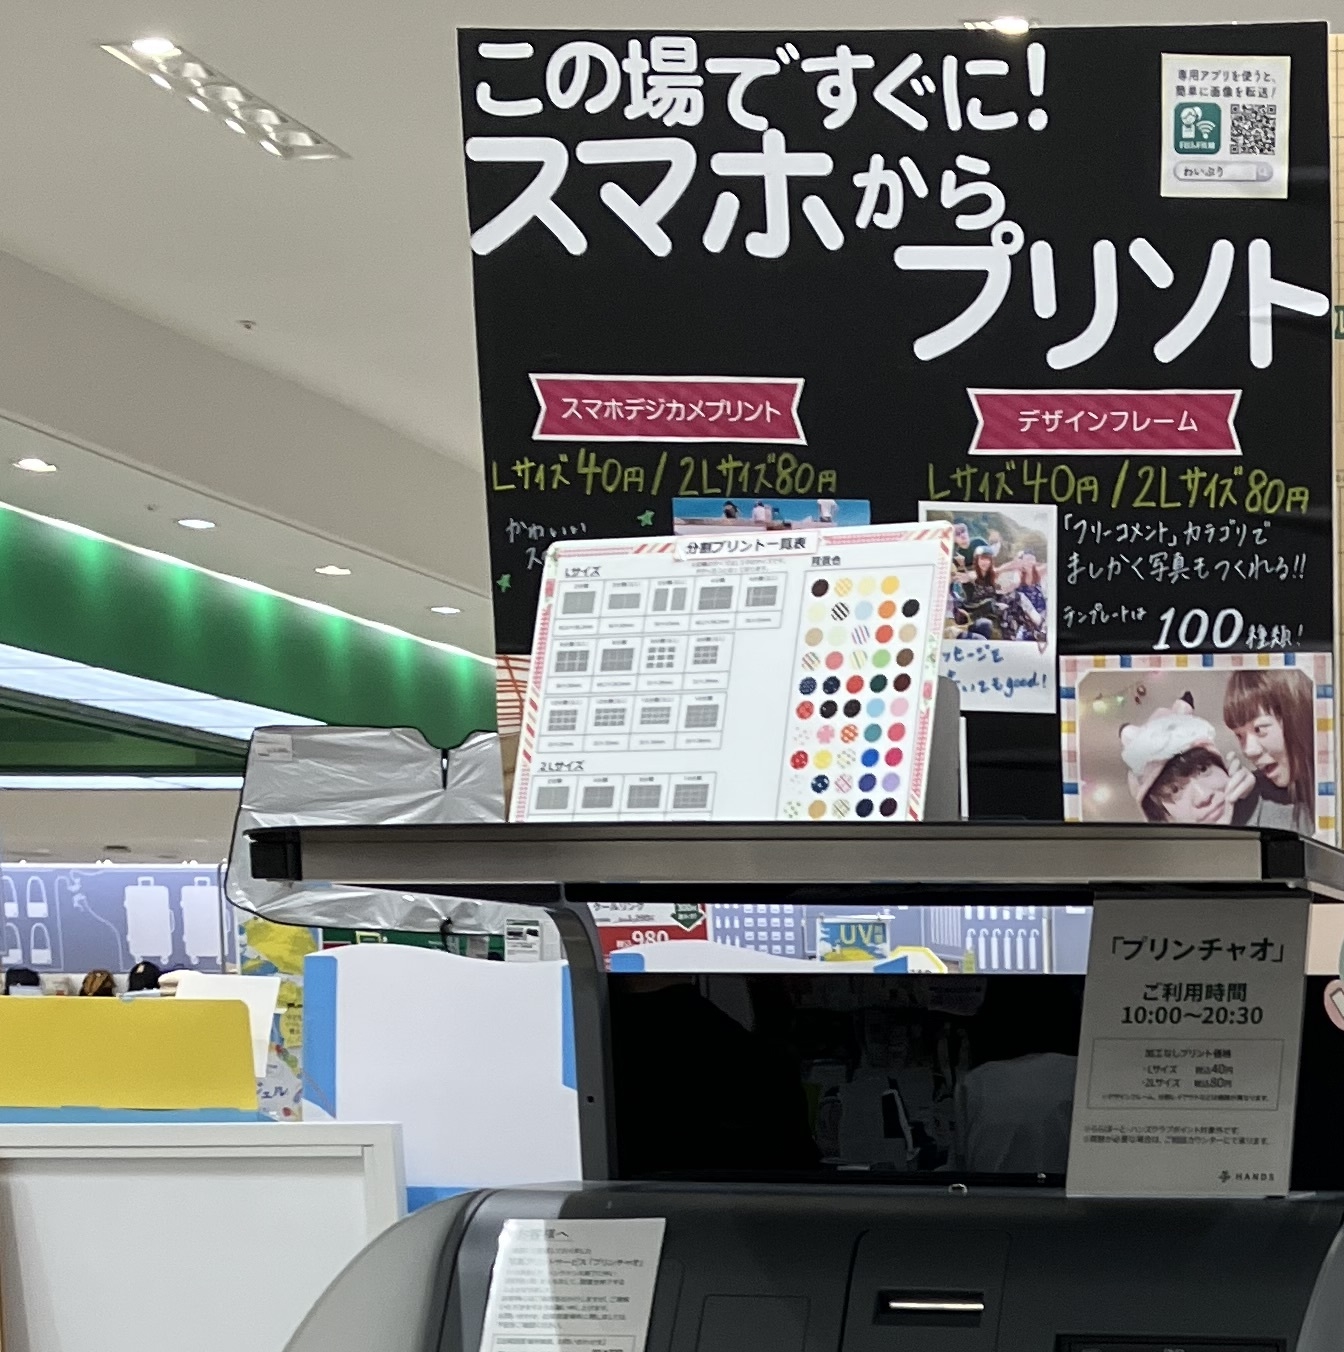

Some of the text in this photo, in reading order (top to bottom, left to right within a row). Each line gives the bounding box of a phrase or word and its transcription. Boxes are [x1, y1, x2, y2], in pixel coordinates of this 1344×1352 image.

[476, 36, 1049, 133] この場ですぐに!
[465, 128, 1006, 258] スマホから
[893, 221, 1331, 370] プリント
[560, 396, 784, 426] スマホデジカメプリント
[1018, 407, 1200, 435] デザインフレーム
[1110, 935, 1286, 964] 「プリンチャオ」
[1141, 982, 1248, 1003] ご利用時間
[1235, 1172, 1275, 1182] HANDS
